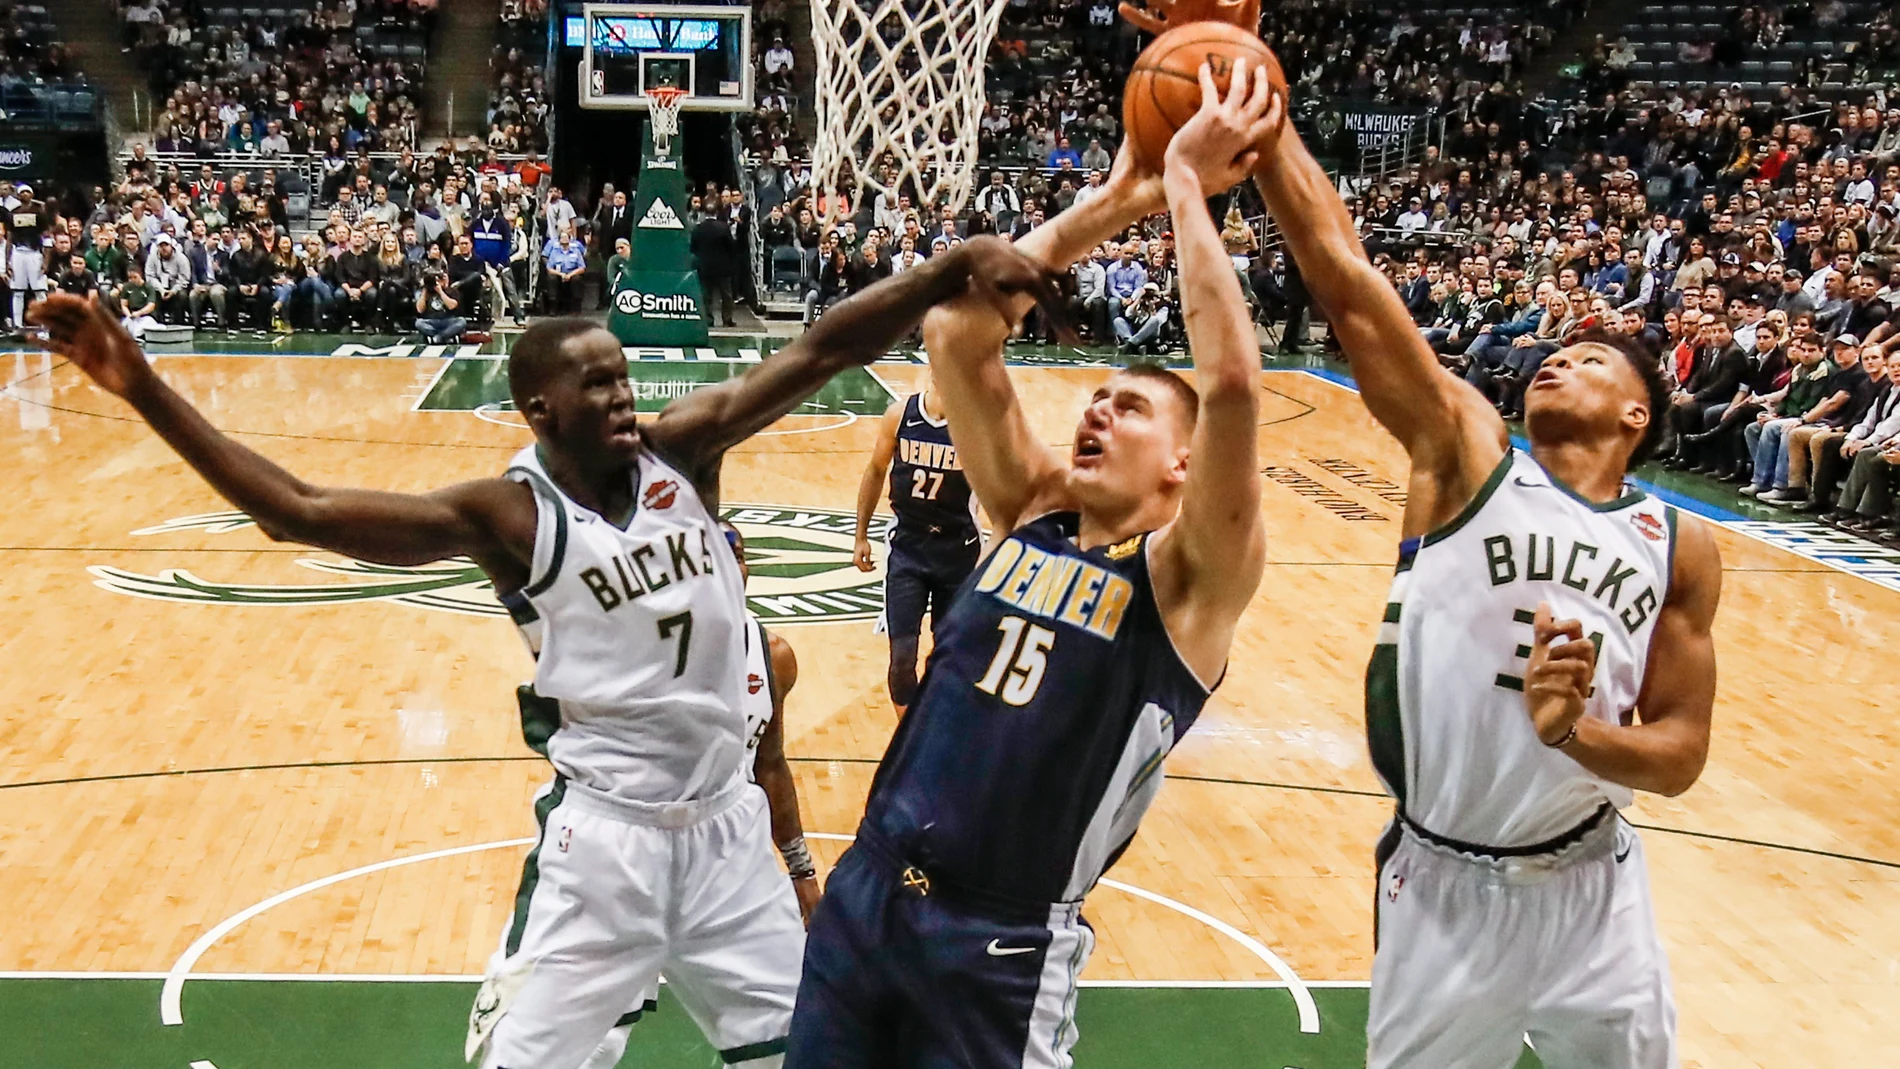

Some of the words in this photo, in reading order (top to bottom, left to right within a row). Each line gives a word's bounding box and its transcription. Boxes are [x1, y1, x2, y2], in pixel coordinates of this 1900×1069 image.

[1344, 112, 1416, 132] MILWAUKEE
[647, 206, 676, 219] Coors
[911, 468, 944, 500] 27
[1484, 533, 1657, 635] BUCKS
[657, 610, 693, 678] 7
[974, 615, 1056, 707] 15
